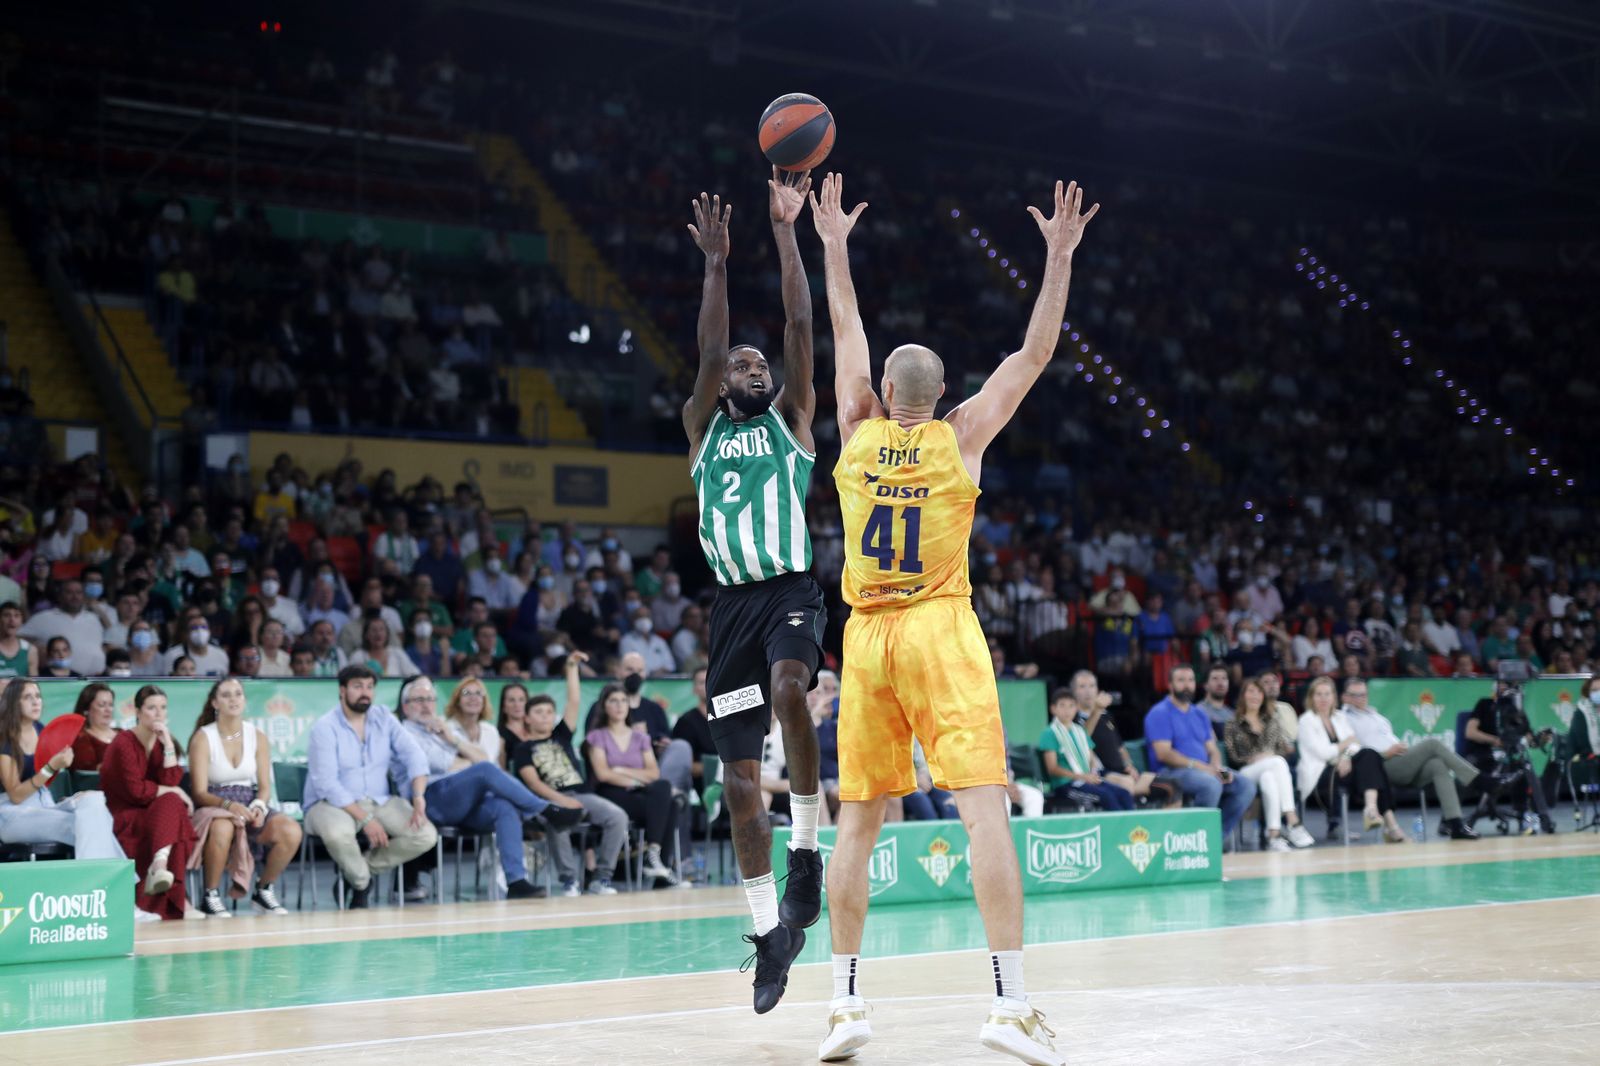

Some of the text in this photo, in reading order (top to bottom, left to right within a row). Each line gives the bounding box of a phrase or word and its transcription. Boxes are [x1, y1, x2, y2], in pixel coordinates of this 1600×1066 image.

[722, 471, 741, 504] 2
[862, 504, 923, 574] 41
[1032, 836, 1098, 871] COOSUR
[1164, 829, 1209, 855] COOSUR
[28, 889, 108, 923] COOSUR
